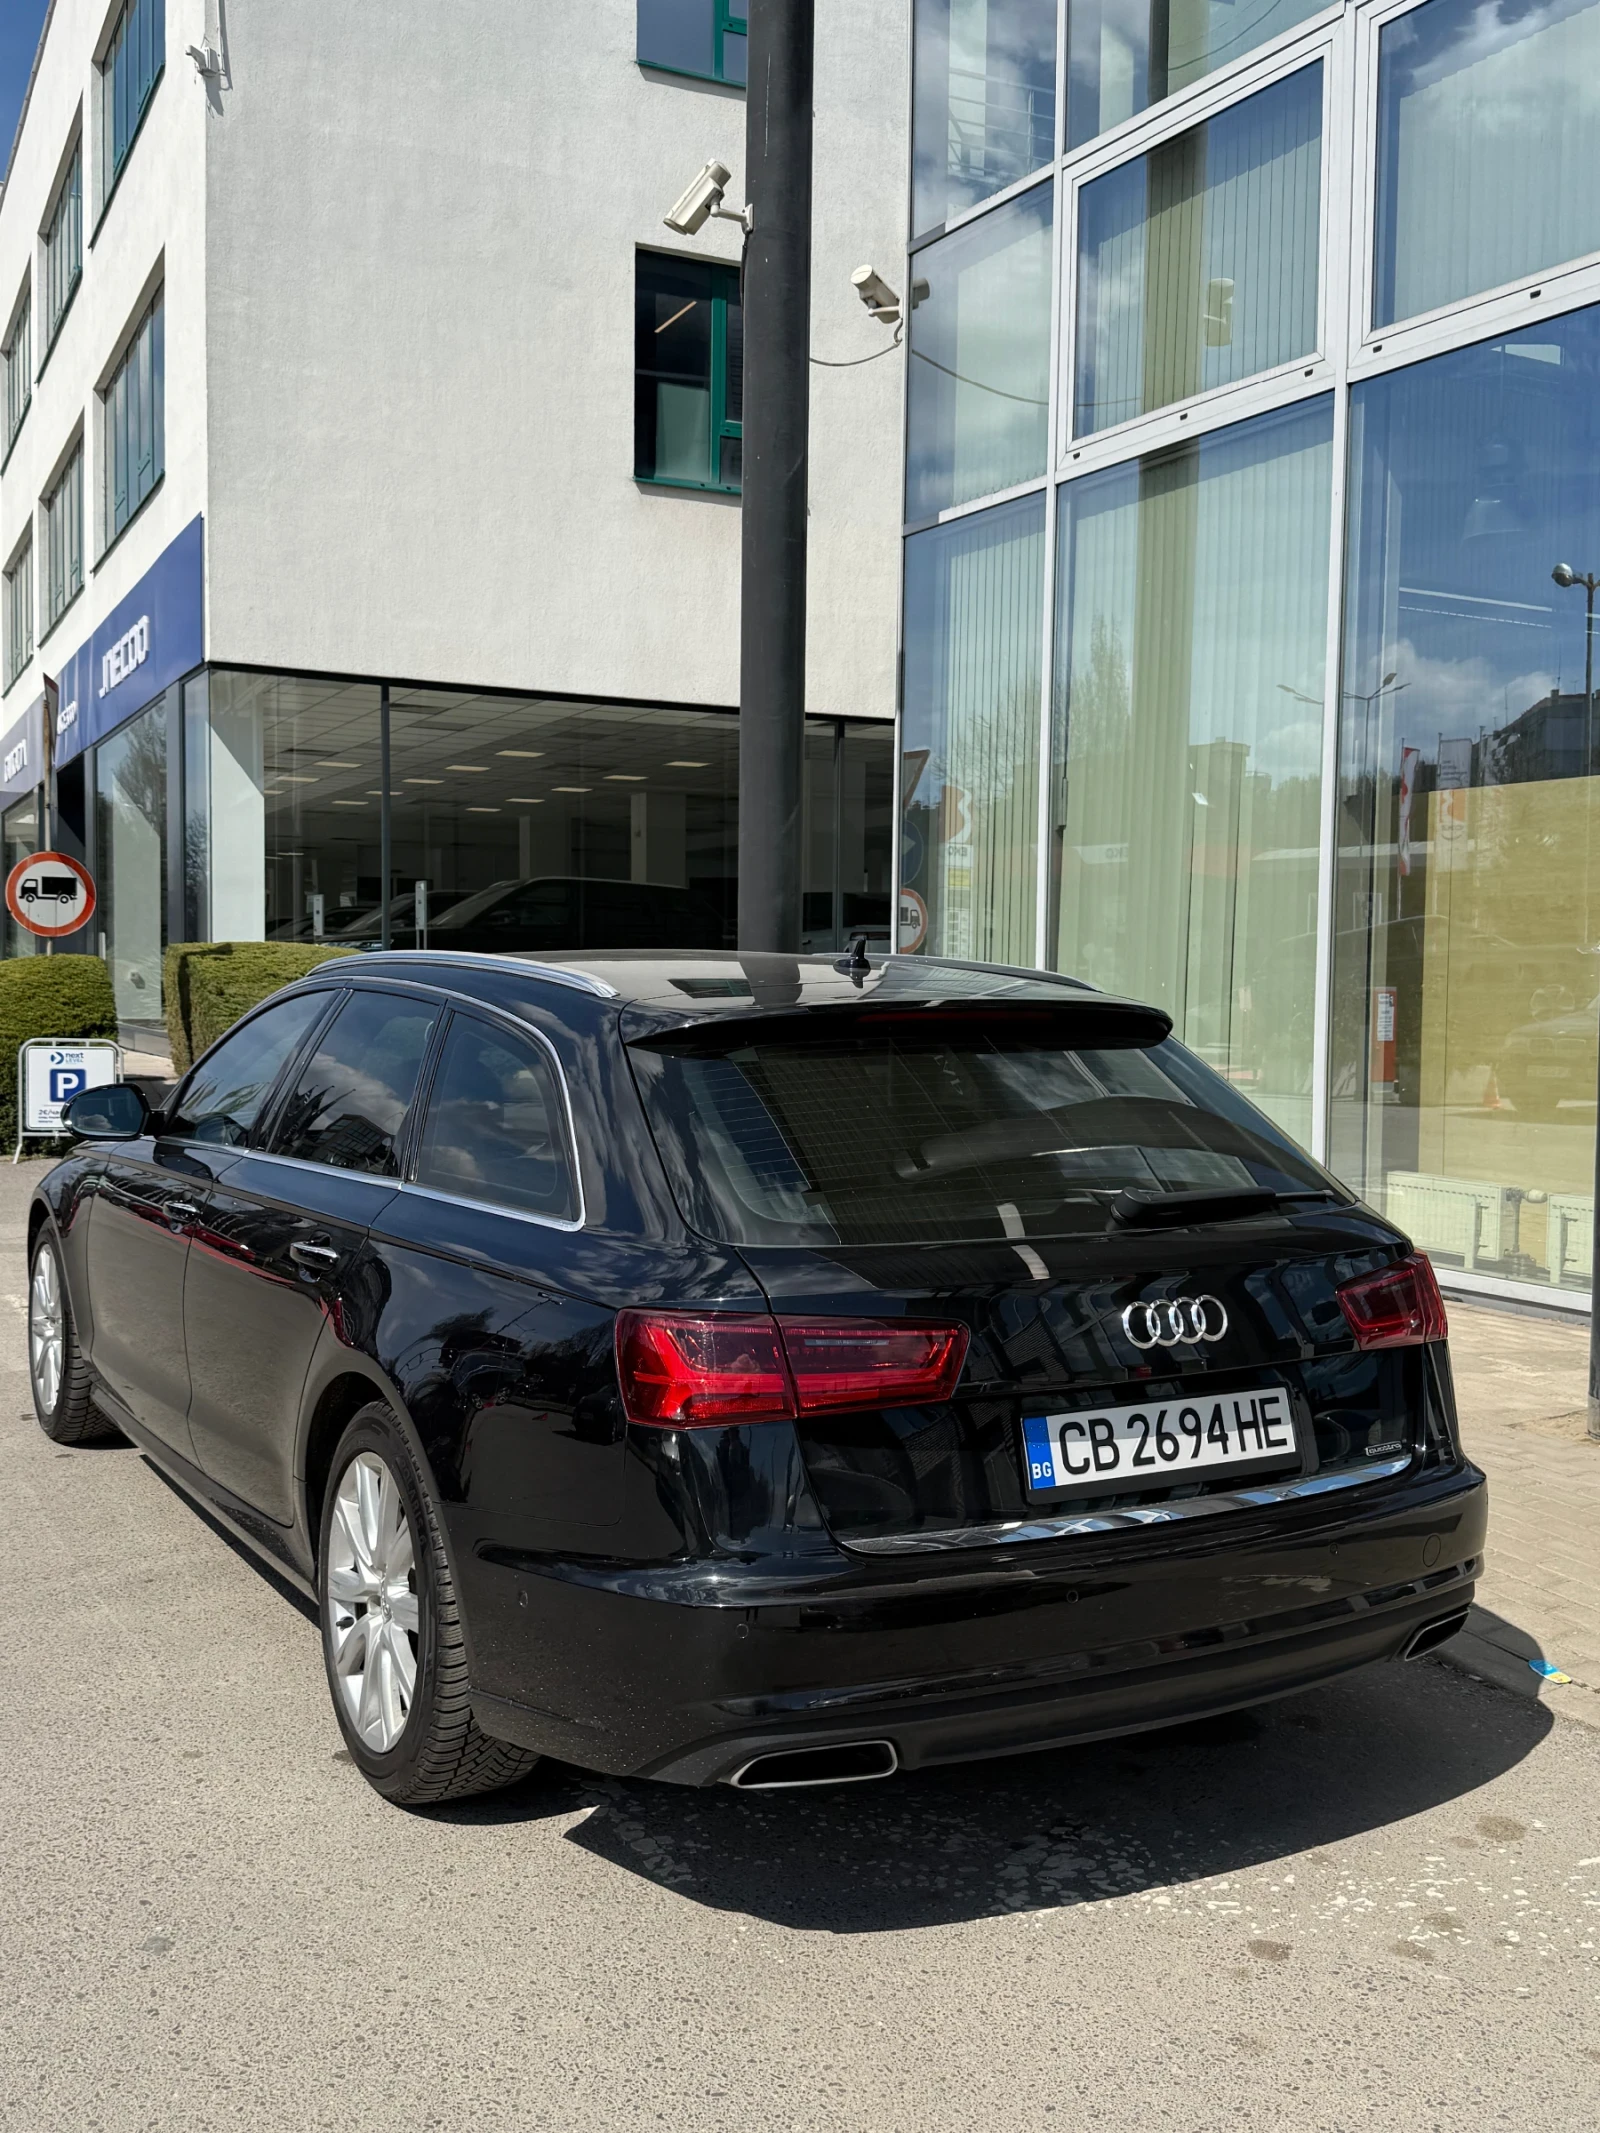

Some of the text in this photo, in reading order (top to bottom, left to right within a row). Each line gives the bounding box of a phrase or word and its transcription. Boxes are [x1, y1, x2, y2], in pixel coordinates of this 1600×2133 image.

[57, 1072, 79, 1098] P
[1126, 1403, 1229, 1467] 2694
[1368, 1443, 1401, 1454] quattro
[1032, 1462, 1052, 1479] BG
